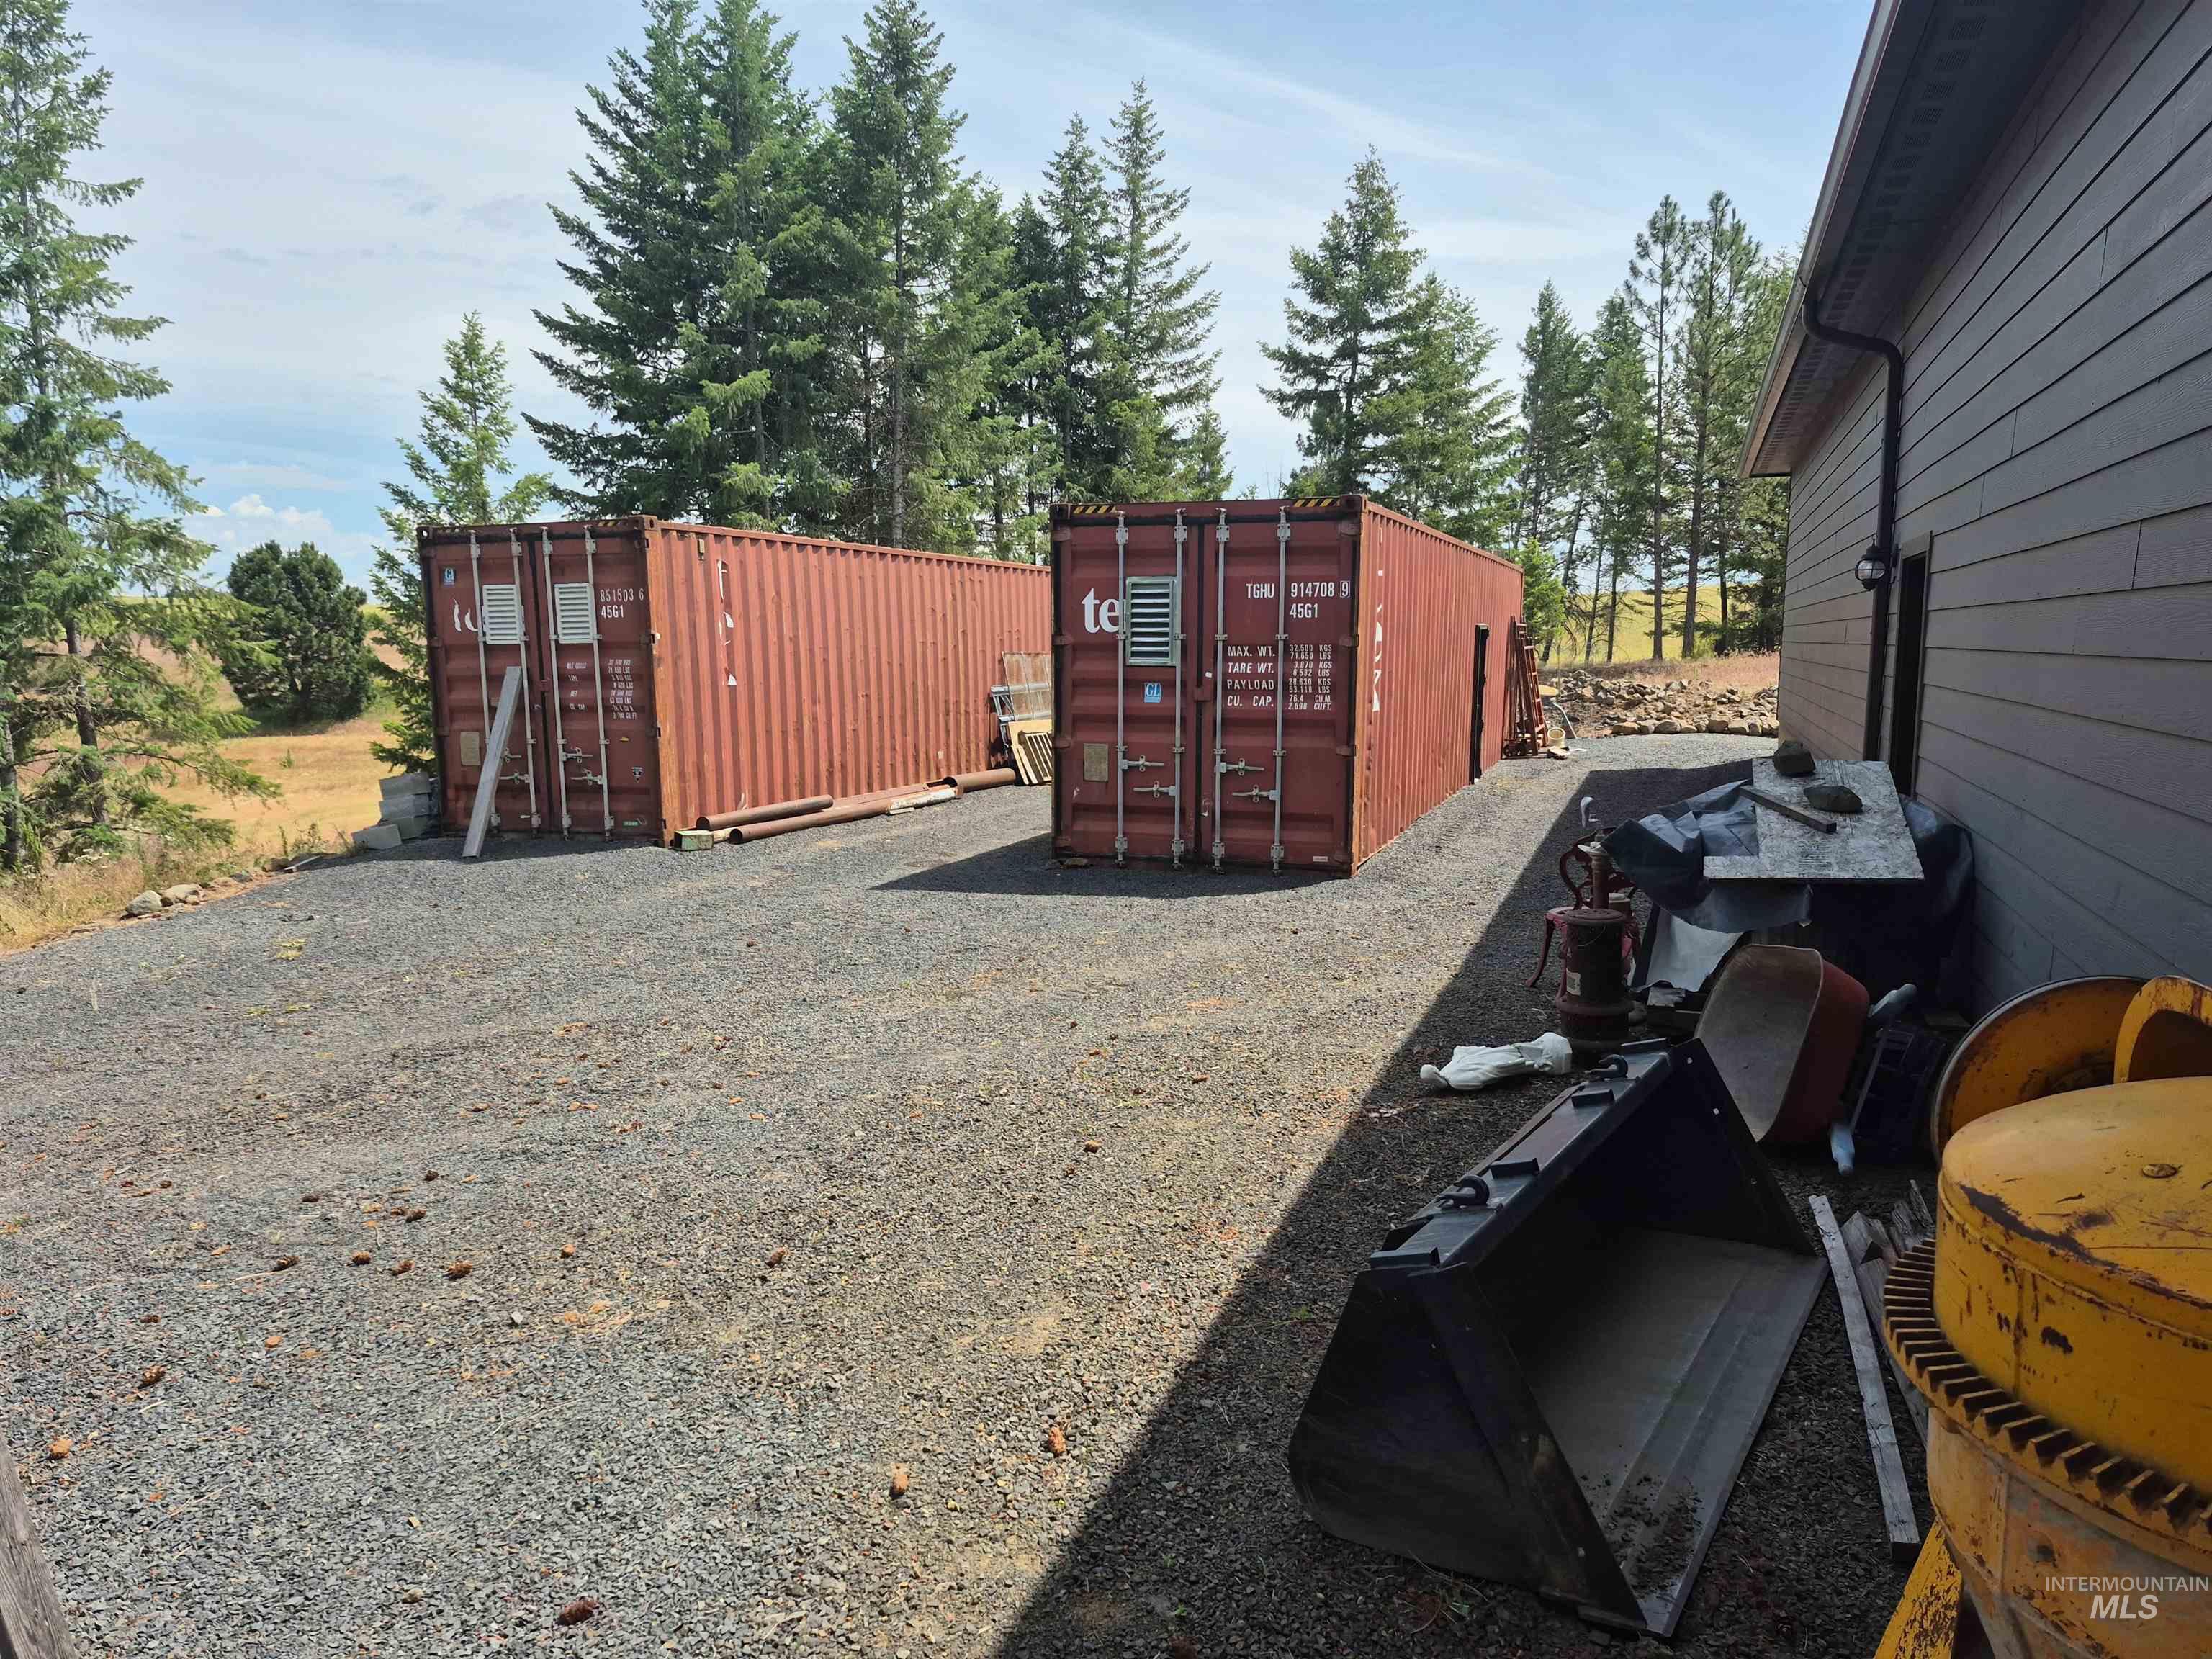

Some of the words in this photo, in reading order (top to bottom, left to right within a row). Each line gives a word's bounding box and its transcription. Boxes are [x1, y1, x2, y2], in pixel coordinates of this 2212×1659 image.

[600, 588, 634, 603] 851503
[639, 588, 644, 601] 6
[1246, 583, 1275, 599] TGHU
[1290, 582, 1335, 598] 914708
[1341, 581, 1349, 597] 9
[601, 606, 624, 619] 45G1
[1082, 587, 1126, 634] te
[1290, 603, 1318, 619] 45G1
[1228, 646, 1252, 657] MAX.
[1257, 646, 1276, 657] WT.
[1228, 662, 1252, 673] TARE
[1257, 662, 1274, 673] WT.
[1226, 679, 1274, 690] PAYLOAD
[1227, 696, 1243, 706] CU.
[1252, 696, 1274, 707] CAP.
